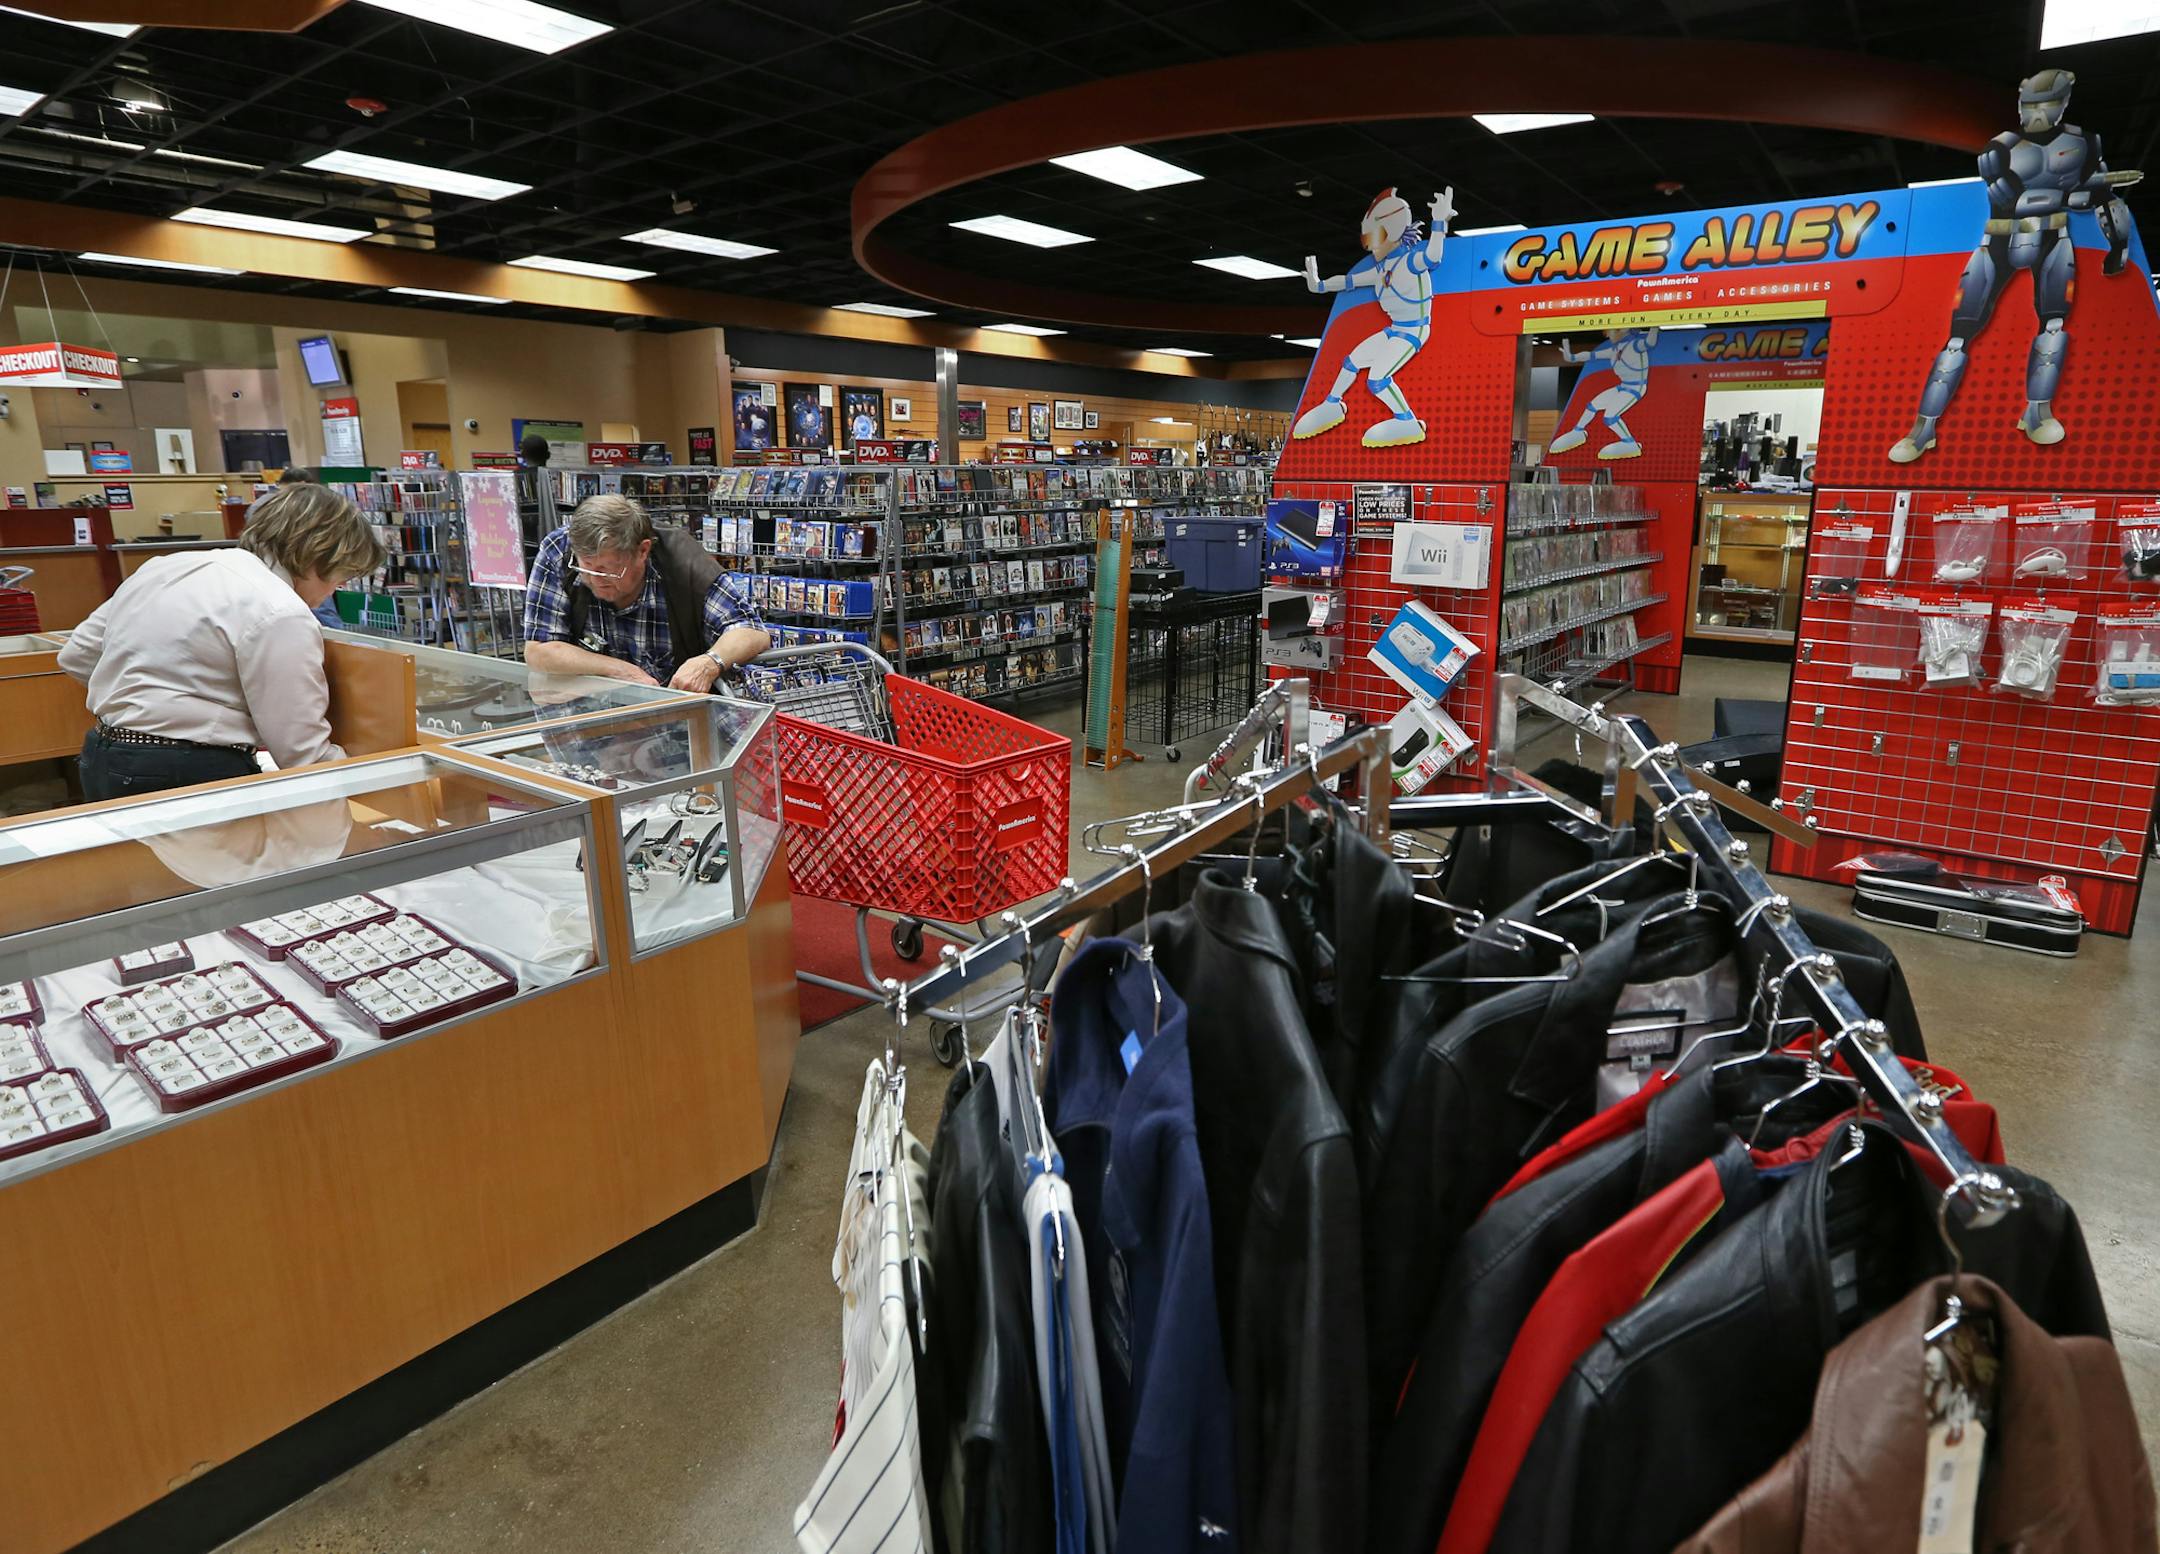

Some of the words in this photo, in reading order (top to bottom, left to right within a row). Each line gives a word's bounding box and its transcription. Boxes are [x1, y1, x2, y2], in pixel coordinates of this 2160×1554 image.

[1503, 221, 1676, 285] GAME
[1681, 200, 1880, 270] ALLEY
[1636, 275, 1699, 288] PawnAmerica
[1520, 300, 1553, 312] GAME
[1561, 295, 1621, 309] SYSTEMS
[1642, 290, 1693, 303] GAMES
[1717, 280, 1832, 299] ACCESSORIES
[1578, 317, 1612, 326] MORE
[1670, 311, 1713, 321] EVERY
[1699, 328, 1807, 361] GAME
[63, 351, 118, 375] CHECKOUT
[1378, 500, 1406, 508] PRICES
[1421, 548, 1448, 563] Wii
[1331, 622, 1345, 632] PS3
[1265, 648, 1292, 657] PS3
[998, 814, 1037, 832] PawnAmerica
